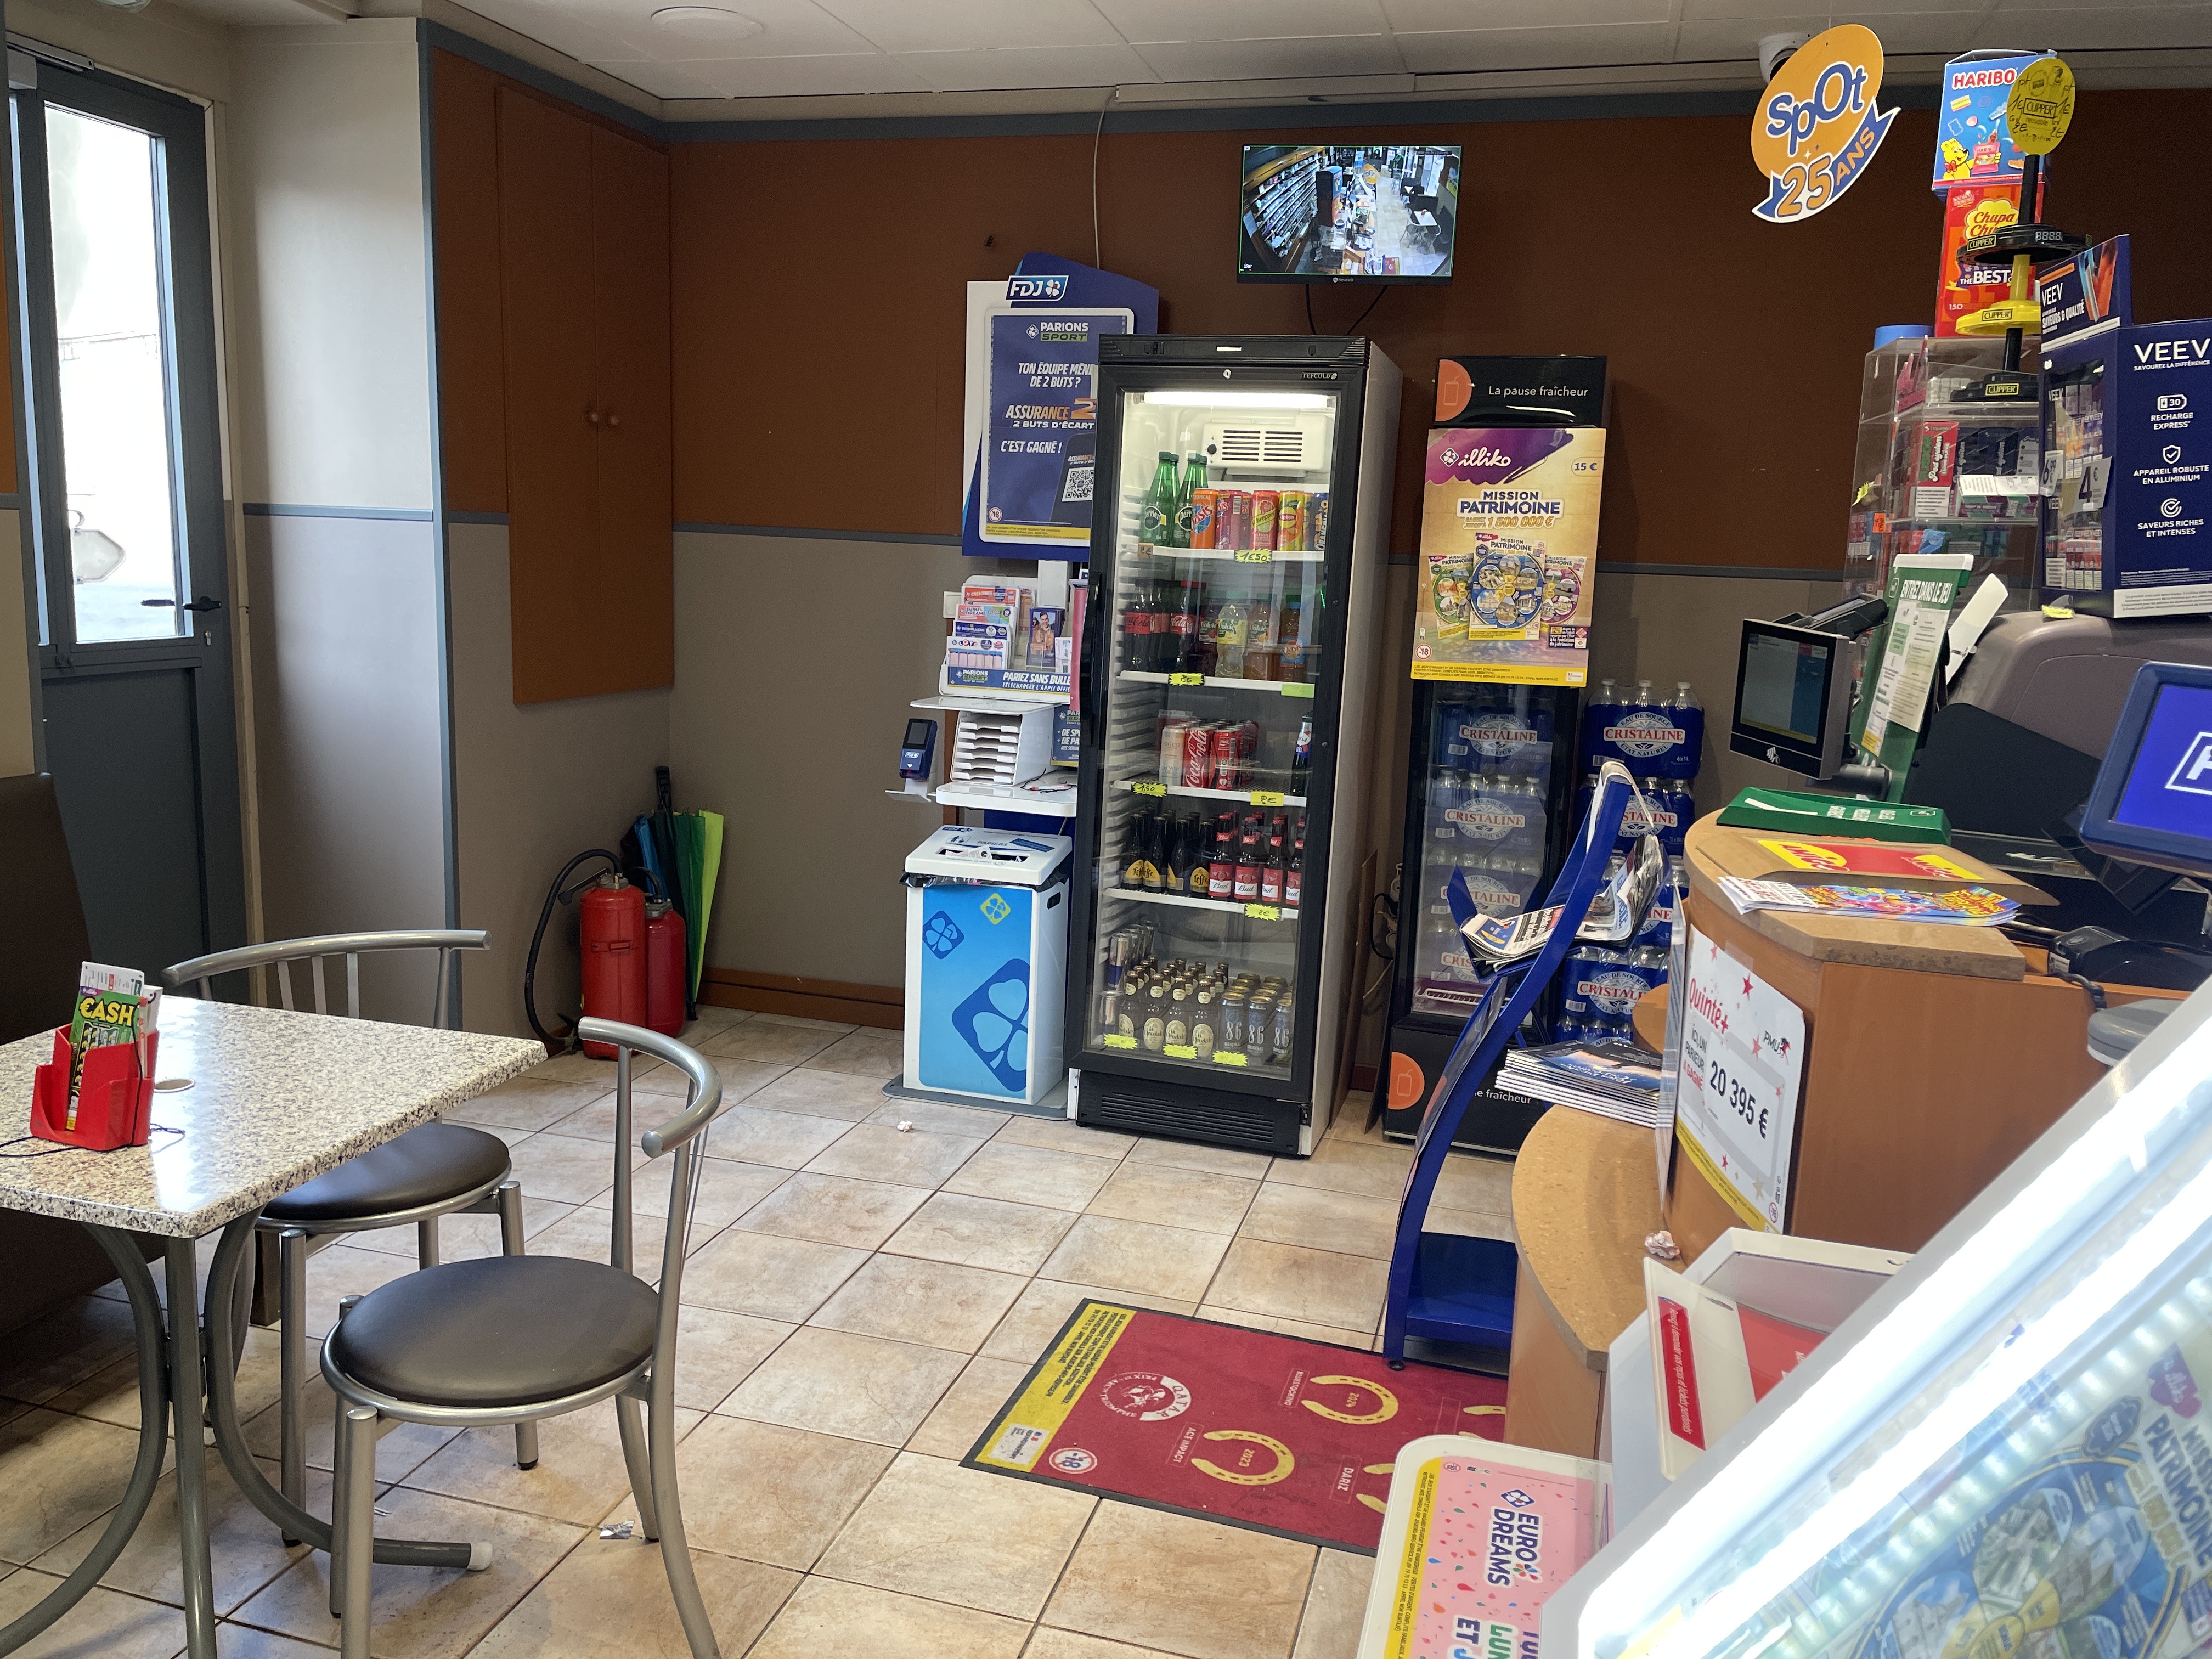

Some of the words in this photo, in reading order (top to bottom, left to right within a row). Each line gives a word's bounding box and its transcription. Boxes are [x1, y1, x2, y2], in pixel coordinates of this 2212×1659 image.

[1953, 69, 2016, 89] HARIBO
[2026, 101, 2053, 115] CLIPPER
[2025, 117, 2049, 126] reusable
[1776, 156, 1832, 217] 25
[1836, 126, 1875, 186] ANS
[1973, 211, 2016, 223] Chupa
[1968, 238, 1995, 250] CLIPPER
[1973, 269, 2008, 284] BEST
[1009, 280, 1044, 297] FDJ
[2041, 282, 2063, 307] VEEV
[1984, 311, 2011, 320] CLIPPER
[2066, 299, 2085, 321] QUALITÉ
[1040, 322, 1088, 332] PARIONS
[1042, 333, 1087, 341] SPORT
[2134, 338, 2211, 363] VEEV
[1018, 363, 1035, 374] TON
[1037, 362, 1069, 375] ÉQUIPE
[2134, 363, 2165, 371] SAVOUREZ
[2175, 359, 2211, 368] DIFFÉRENCE
[1029, 376, 1042, 387] DE
[1043, 377, 1050, 387] 2
[1050, 376, 1074, 388] BUTS
[1075, 377, 1081, 388] ?
[1488, 386, 1500, 396] La
[1504, 387, 1537, 398] pause
[1539, 386, 1589, 397] fraîcheur
[1988, 385, 2017, 394] CLIPPER
[2048, 387, 2063, 402] VEEV
[1005, 404, 1070, 420] ASSURANCE
[2150, 411, 2193, 421] RECHARGE
[1051, 420, 1095, 430] D'ÉCART
[1000, 440, 1026, 453] C'EST
[1026, 441, 1057, 454] GAGNÉ
[1458, 447, 1511, 467] illiko
[1575, 462, 1587, 471] 15
[1590, 462, 1598, 471] €
[2133, 466, 2171, 477] APPAREIL
[2172, 464, 2209, 474] ROBUSTE
[2078, 466, 2092, 503] 4
[2154, 475, 2200, 483] ALUMINIUM
[1483, 490, 1539, 500] MISSION
[1460, 501, 1561, 514] PATRIMOINE
[2047, 497, 2064, 510] VEEV
[1487, 516, 1494, 527] 1
[1494, 516, 1519, 528] 500
[1520, 515, 1544, 527] 000
[1545, 515, 1554, 527] €
[2138, 521, 2175, 529] SAVEURS
[2175, 518, 2204, 527] RICHES
[2157, 528, 2196, 537] INTENSES
[1491, 541, 1532, 551] PATRIMOINE
[1900, 579, 1923, 601] ENTREZ
[1918, 581, 1937, 602] DANS
[1931, 583, 1944, 603] LE
[1938, 583, 1954, 605] JEU
[1218, 622, 1234, 630] Volvic
[1002, 672, 1029, 682] PARIEZ
[1029, 673, 1048, 684] SANS
[1002, 681, 1035, 690] TÉLÉCHARGEZ
[1620, 715, 1634, 726] EAU
[1646, 714, 1671, 727] SOURCE
[1061, 728, 1070, 737] DE
[1461, 726, 1536, 743] CRISTALINE
[1605, 729, 1684, 741] CRISTALINE
[1061, 737, 1070, 745] DE
[1637, 745, 1668, 757] NATUREL
[1185, 729, 1208, 788] Coca-Cola
[1462, 799, 1474, 809] EAU
[1486, 798, 1510, 812] SOURCE
[1446, 810, 1523, 826] CRISTALINE
[1193, 874, 1208, 885] Leffe
[1237, 884, 1254, 893] Bud
[1595, 974, 1610, 983] EAU
[1579, 983, 1647, 1001] CRISTALI
[1689, 978, 1729, 1035] Quinté+
[1226, 1021, 1242, 1041] 86
[1248, 1024, 1265, 1045] 86
[1274, 1027, 1289, 1048] 86
[1764, 1030, 1781, 1055] PMU
[1685, 1041, 1705, 1073] PARIEUR
[1687, 1066, 1703, 1091] GAGNÉ
[1486, 1090, 1532, 1104] fraîcheur
[1710, 1060, 1727, 1097] 20
[1730, 1079, 1756, 1125] 395
[1759, 1108, 1769, 1139] €
[1156, 1385, 1189, 1418] QATAR
[1345, 1392, 1359, 1408] 2024
[1679, 1403, 1692, 1435] perdants
[1186, 1426, 1197, 1440] ACE
[1172, 1440, 1190, 1463] IMPACT
[1238, 1448, 1255, 1468] 2023
[1515, 1513, 1539, 1562] EURO
[1487, 1508, 1515, 1587] DREAMS
[1455, 1617, 1481, 1645] ET
